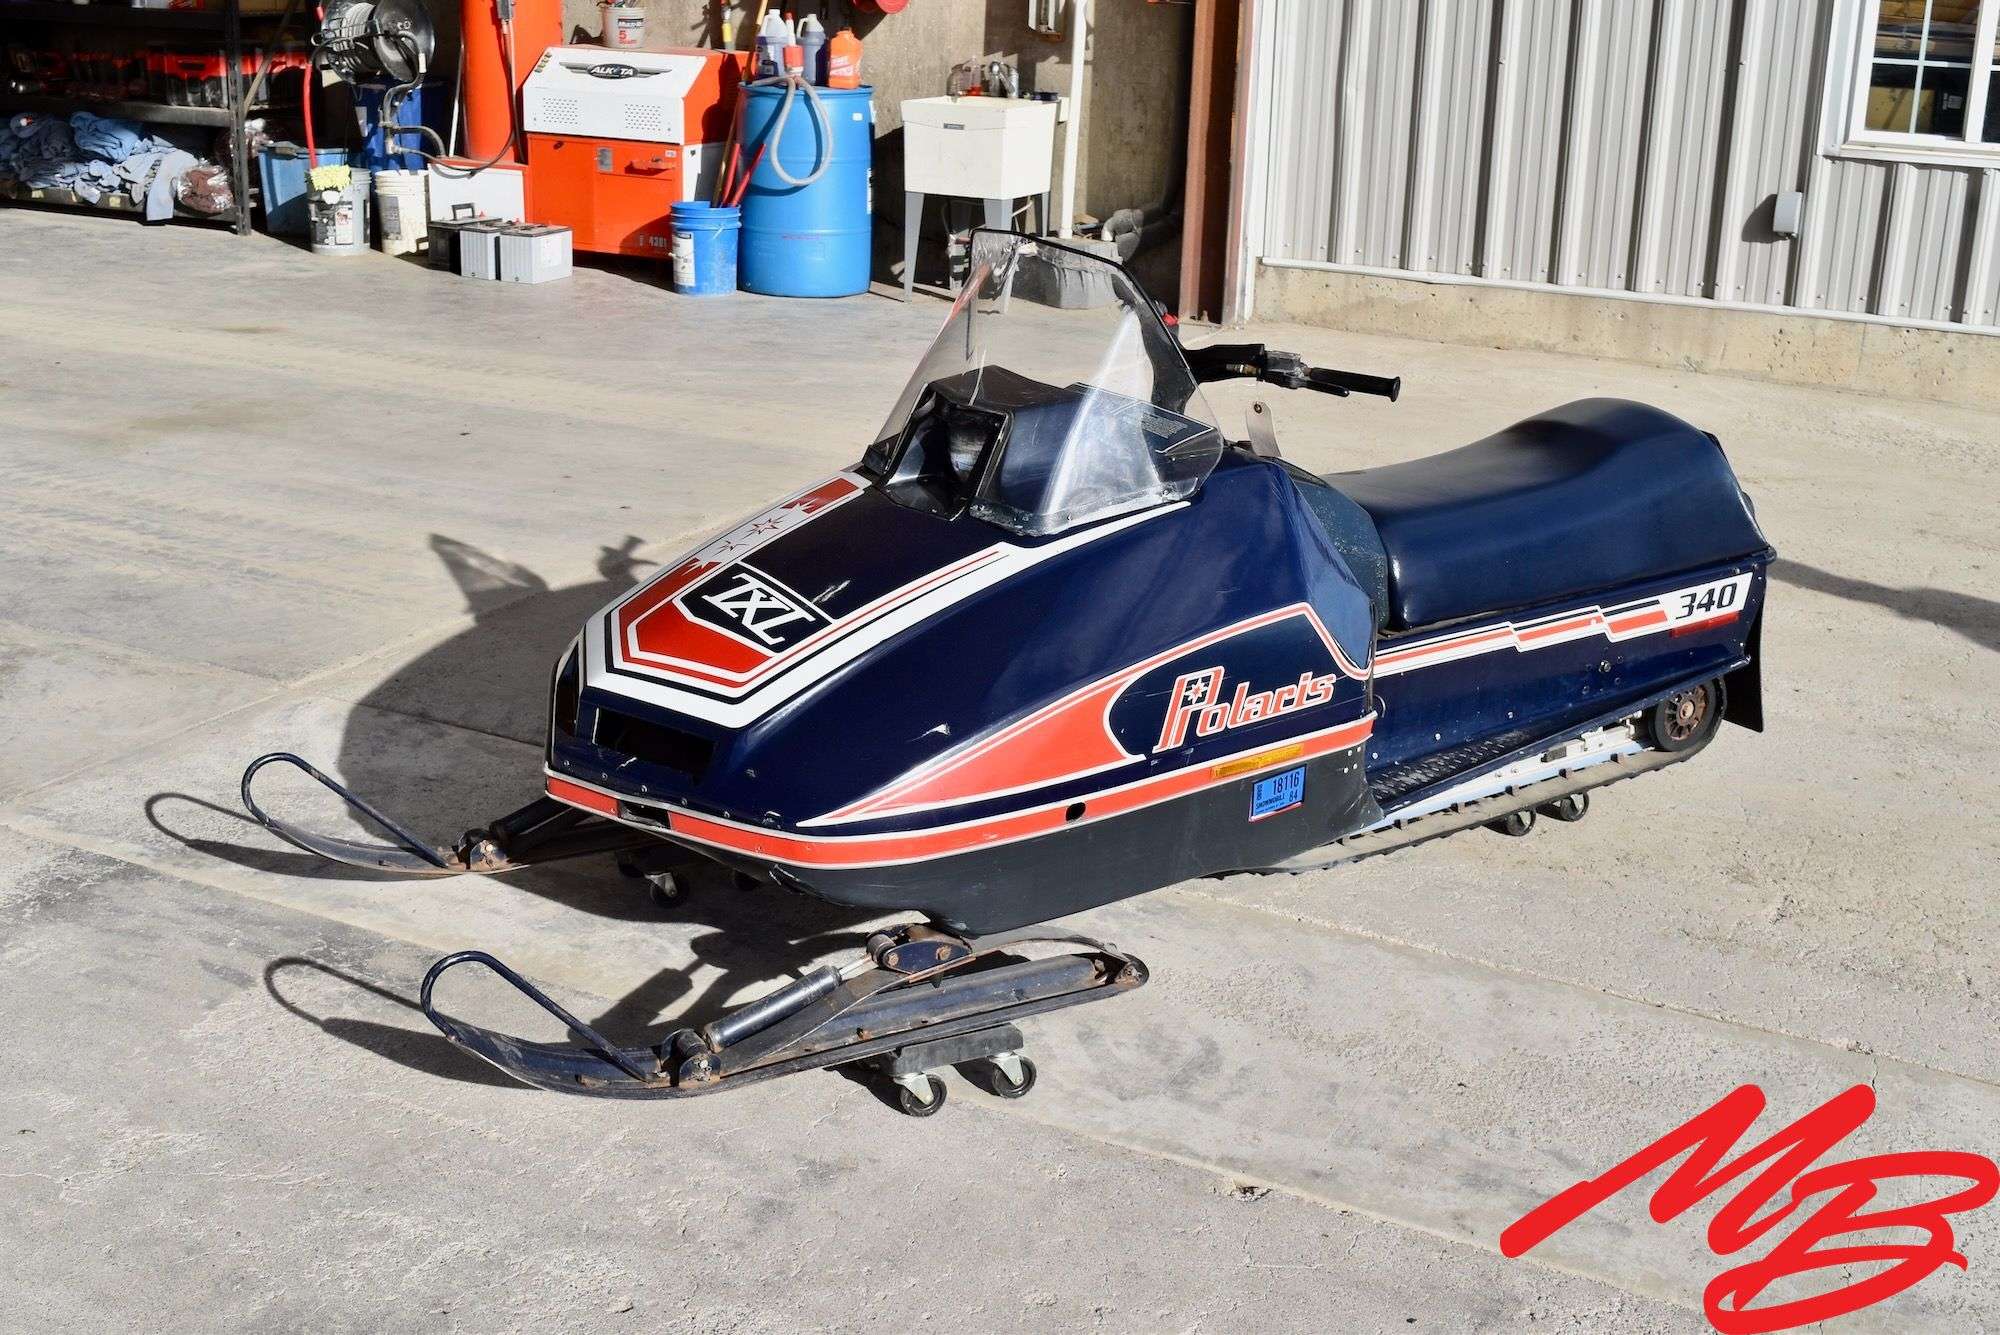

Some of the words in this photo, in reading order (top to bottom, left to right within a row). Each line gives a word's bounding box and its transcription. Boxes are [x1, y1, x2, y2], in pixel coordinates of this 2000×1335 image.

[1675, 582, 1738, 620] 340
[1152, 665, 1336, 753] Polaris
[1272, 770, 1300, 796] 18116
[1288, 789, 1299, 802] 84
